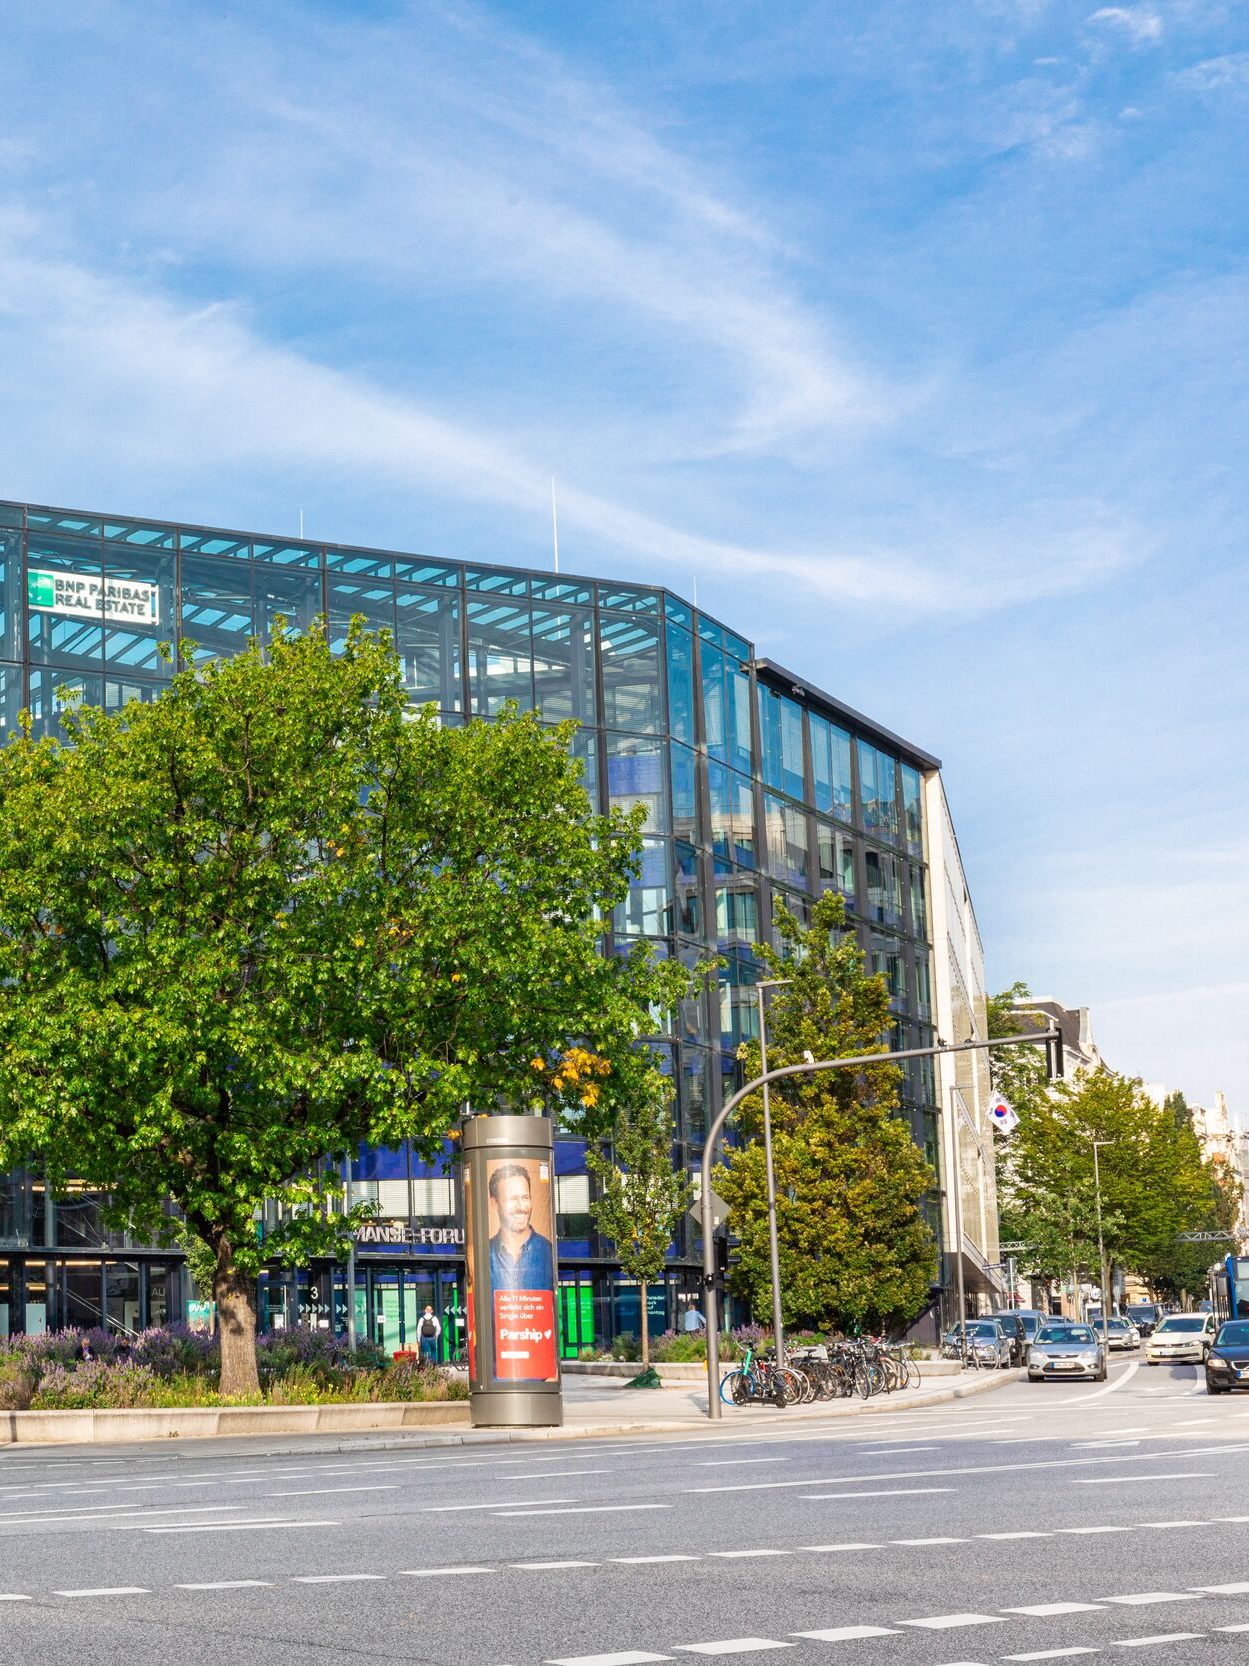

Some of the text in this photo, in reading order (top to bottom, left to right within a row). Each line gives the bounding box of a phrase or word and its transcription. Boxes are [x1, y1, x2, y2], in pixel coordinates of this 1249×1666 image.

[55, 579, 150, 602] BNP PARIBAS
[55, 593, 146, 616] REAL ESTATE
[355, 1226, 465, 1244] HANSE-FORU
[151, 1287, 166, 1297] AU
[310, 1286, 319, 1300] 3
[499, 1312, 518, 1320] Single
[500, 1328, 543, 1343] Parship
